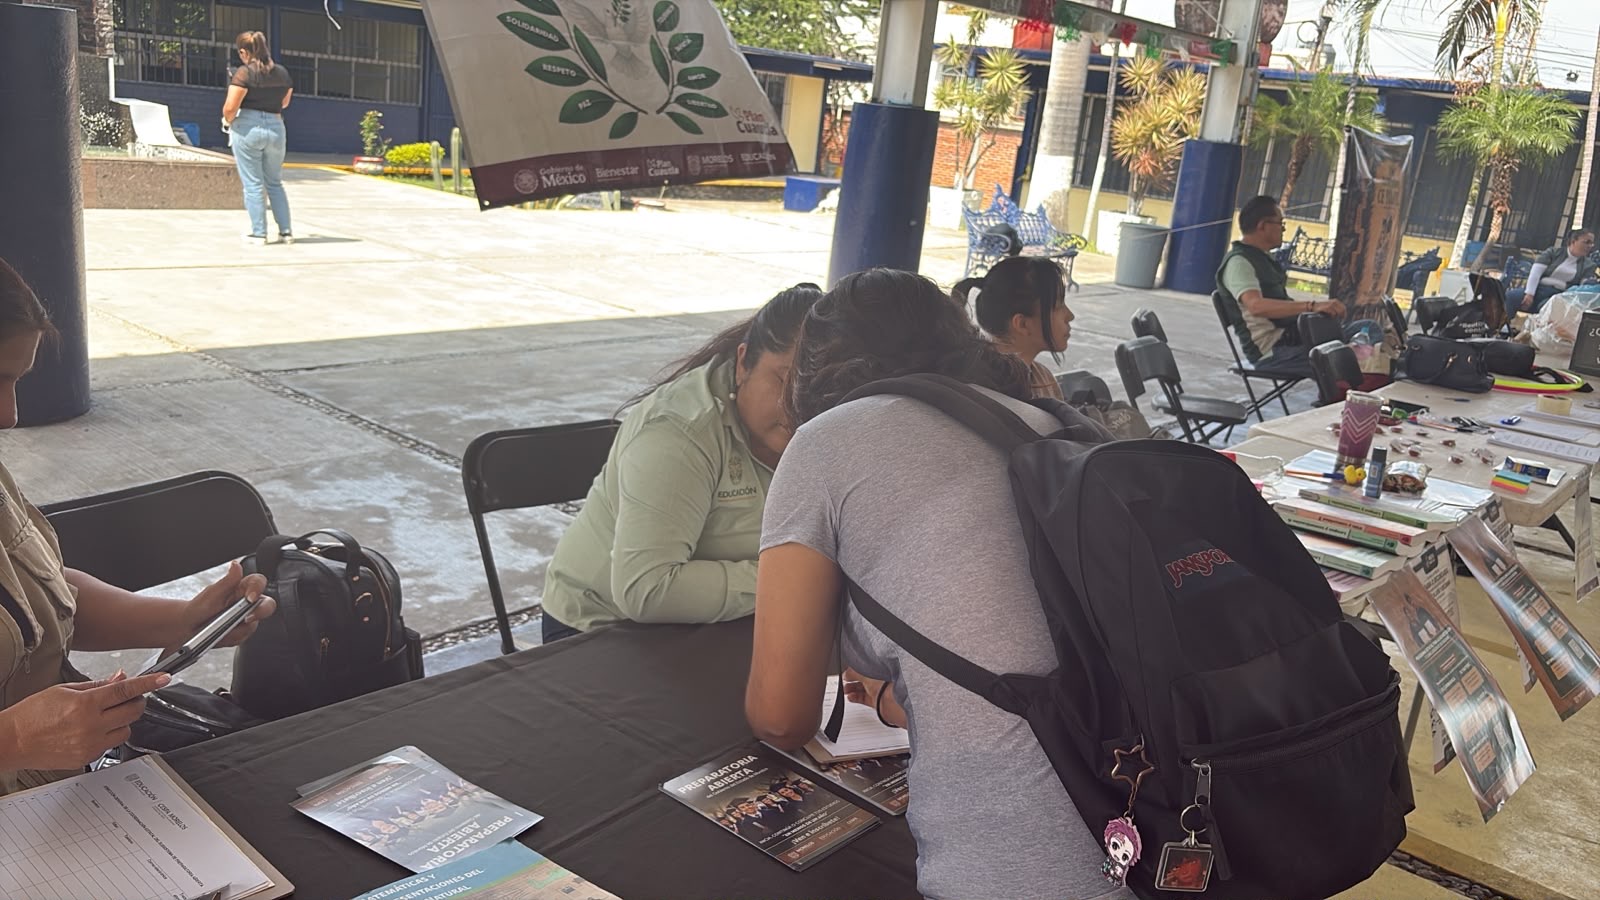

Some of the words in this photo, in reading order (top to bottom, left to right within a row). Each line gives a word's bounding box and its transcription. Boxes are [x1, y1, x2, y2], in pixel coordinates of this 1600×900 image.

[506, 15, 560, 42] SOLIDARIDAD
[542, 63, 577, 77] RESPETO
[541, 172, 586, 188] México
[574, 164, 584, 172] de
[595, 163, 639, 178] Bienestar
[1165, 548, 1234, 588] JANSPO
[677, 755, 758, 794] PREPARATORIA
[707, 767, 754, 792] ABIERTA
[419, 815, 513, 870] PREPARATORIA
[427, 821, 481, 853] ABIERTA
[361, 876, 429, 900] ATEMÁTICAS
[394, 875, 465, 900] SENTACIONES
[464, 868, 485, 877] DEL
